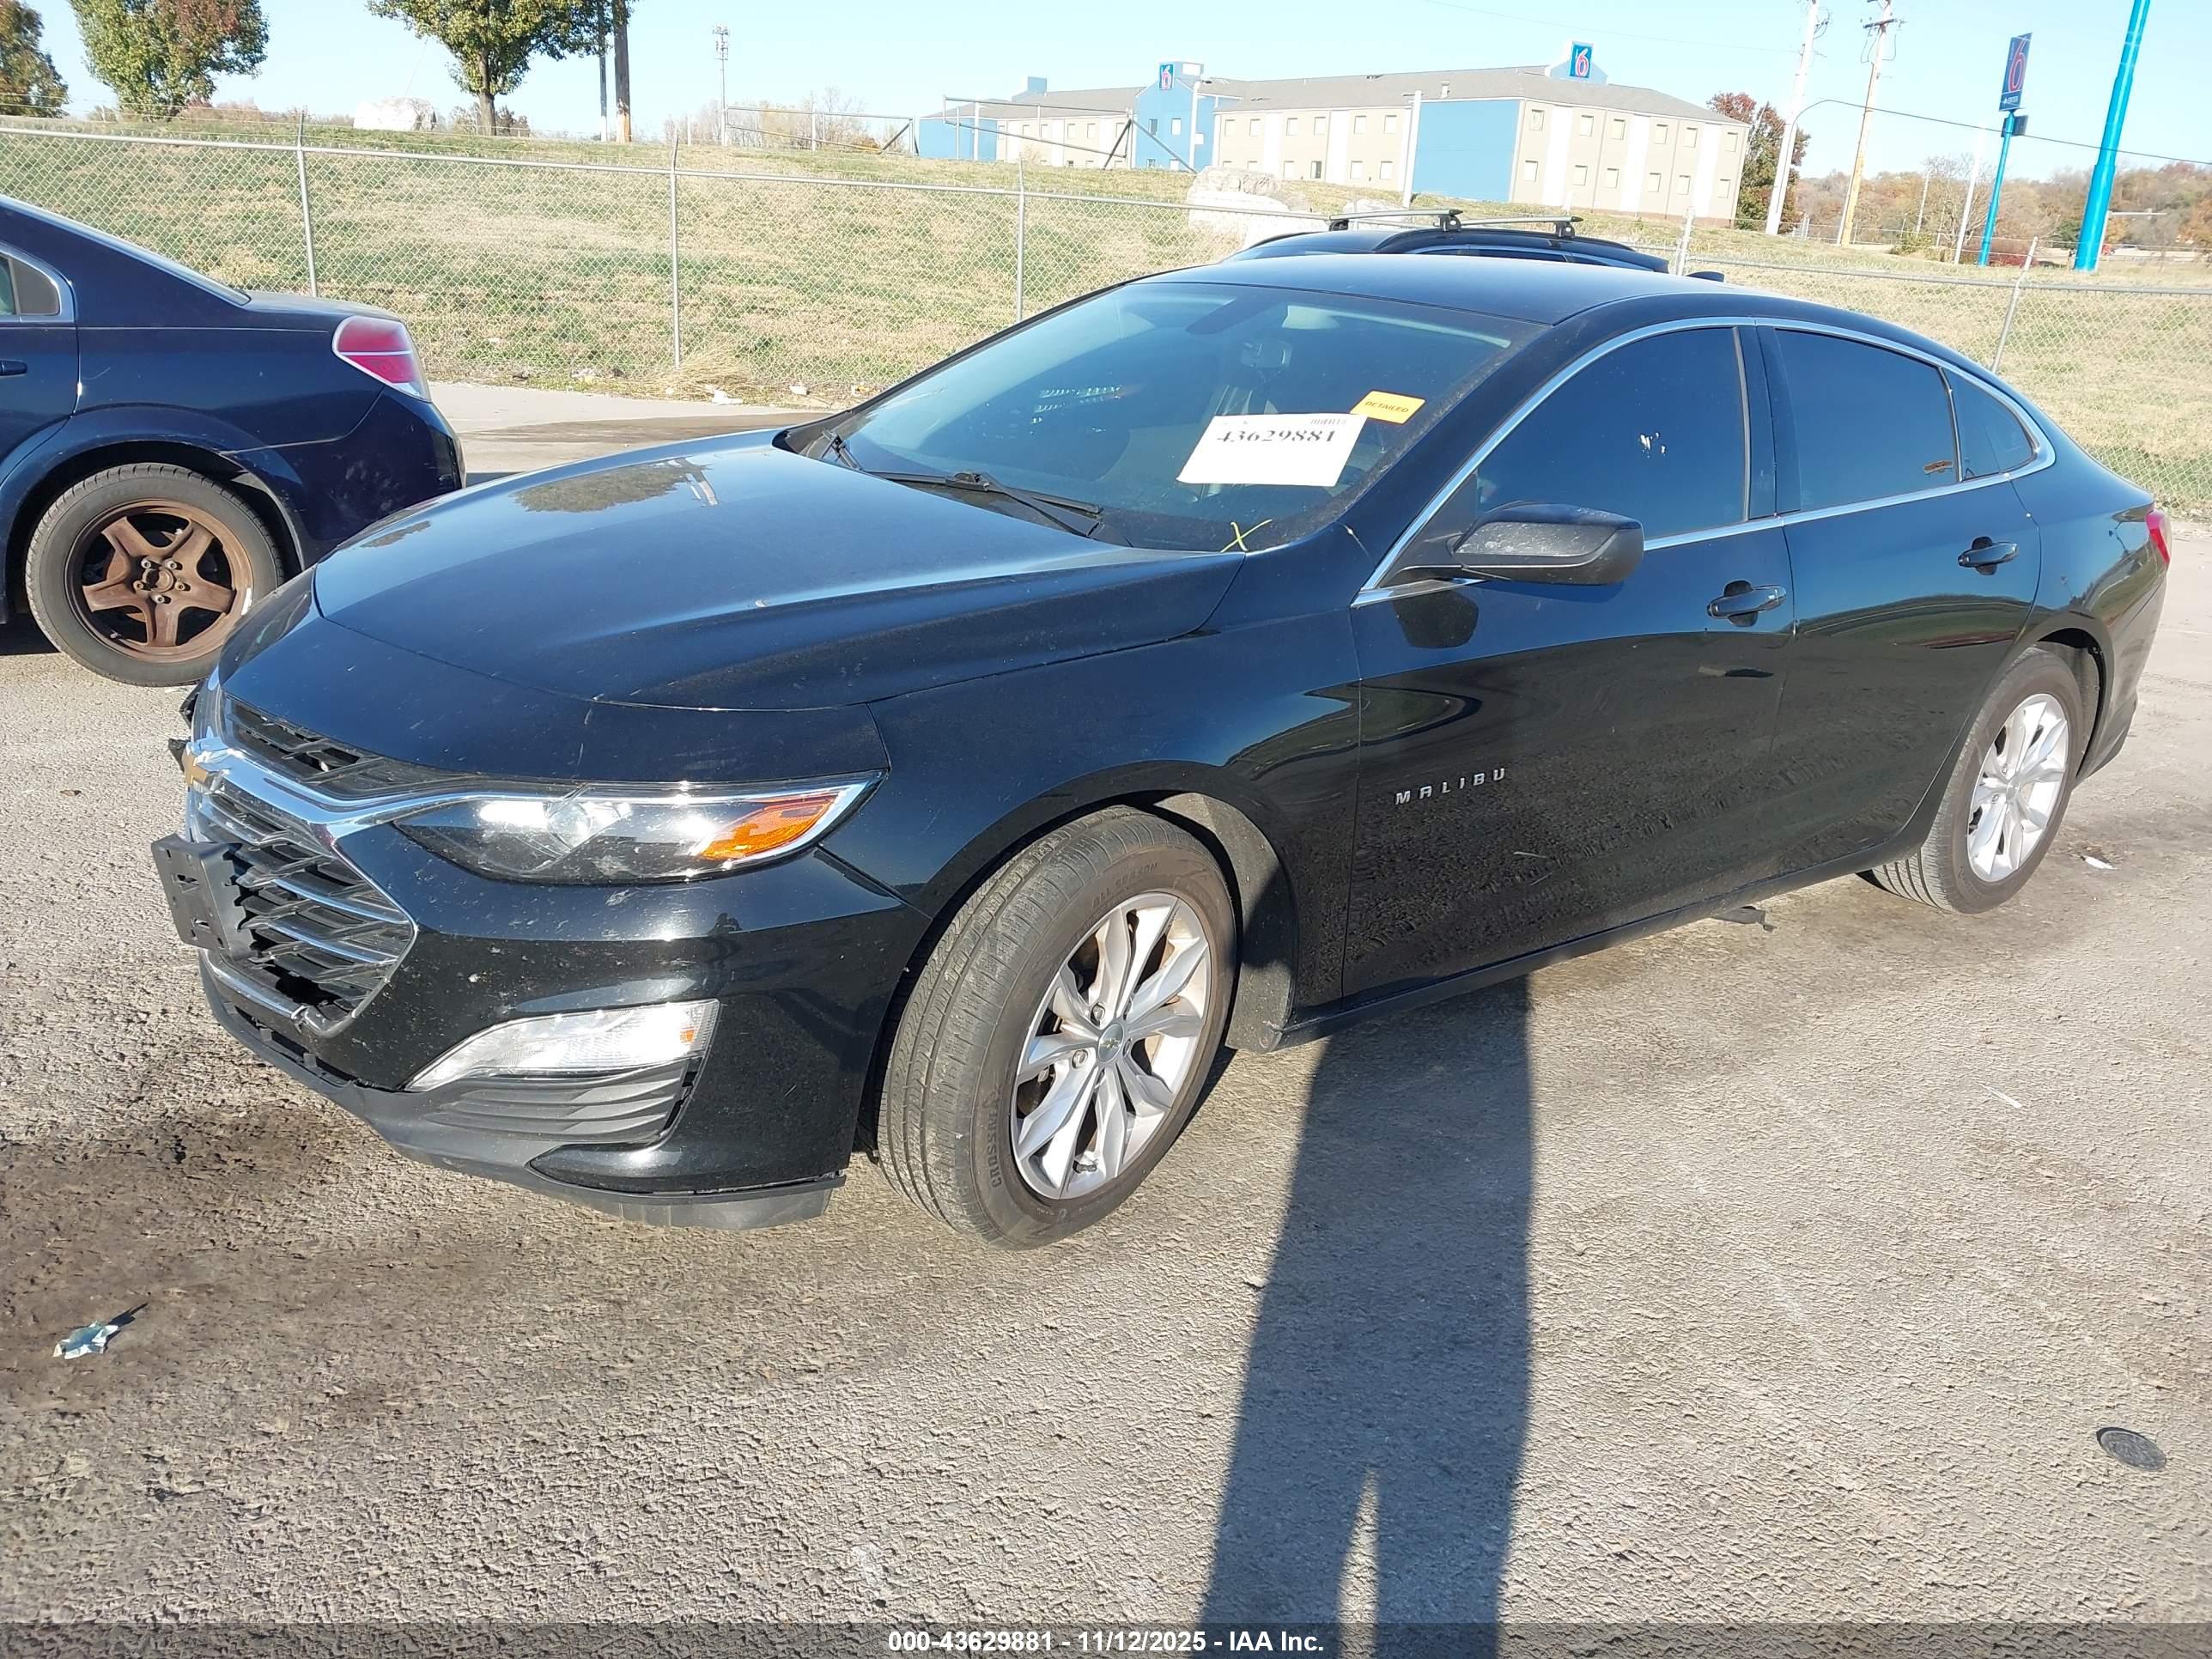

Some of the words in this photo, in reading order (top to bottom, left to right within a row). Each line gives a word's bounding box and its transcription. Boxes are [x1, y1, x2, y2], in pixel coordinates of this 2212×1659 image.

[1575, 47, 1589, 76] 6
[2008, 36, 2027, 92] 6
[1161, 64, 1172, 90] 6
[1364, 400, 1409, 414] DETAILED
[1216, 429, 1337, 443] 43629881
[1395, 767, 1506, 805] MALIBU
